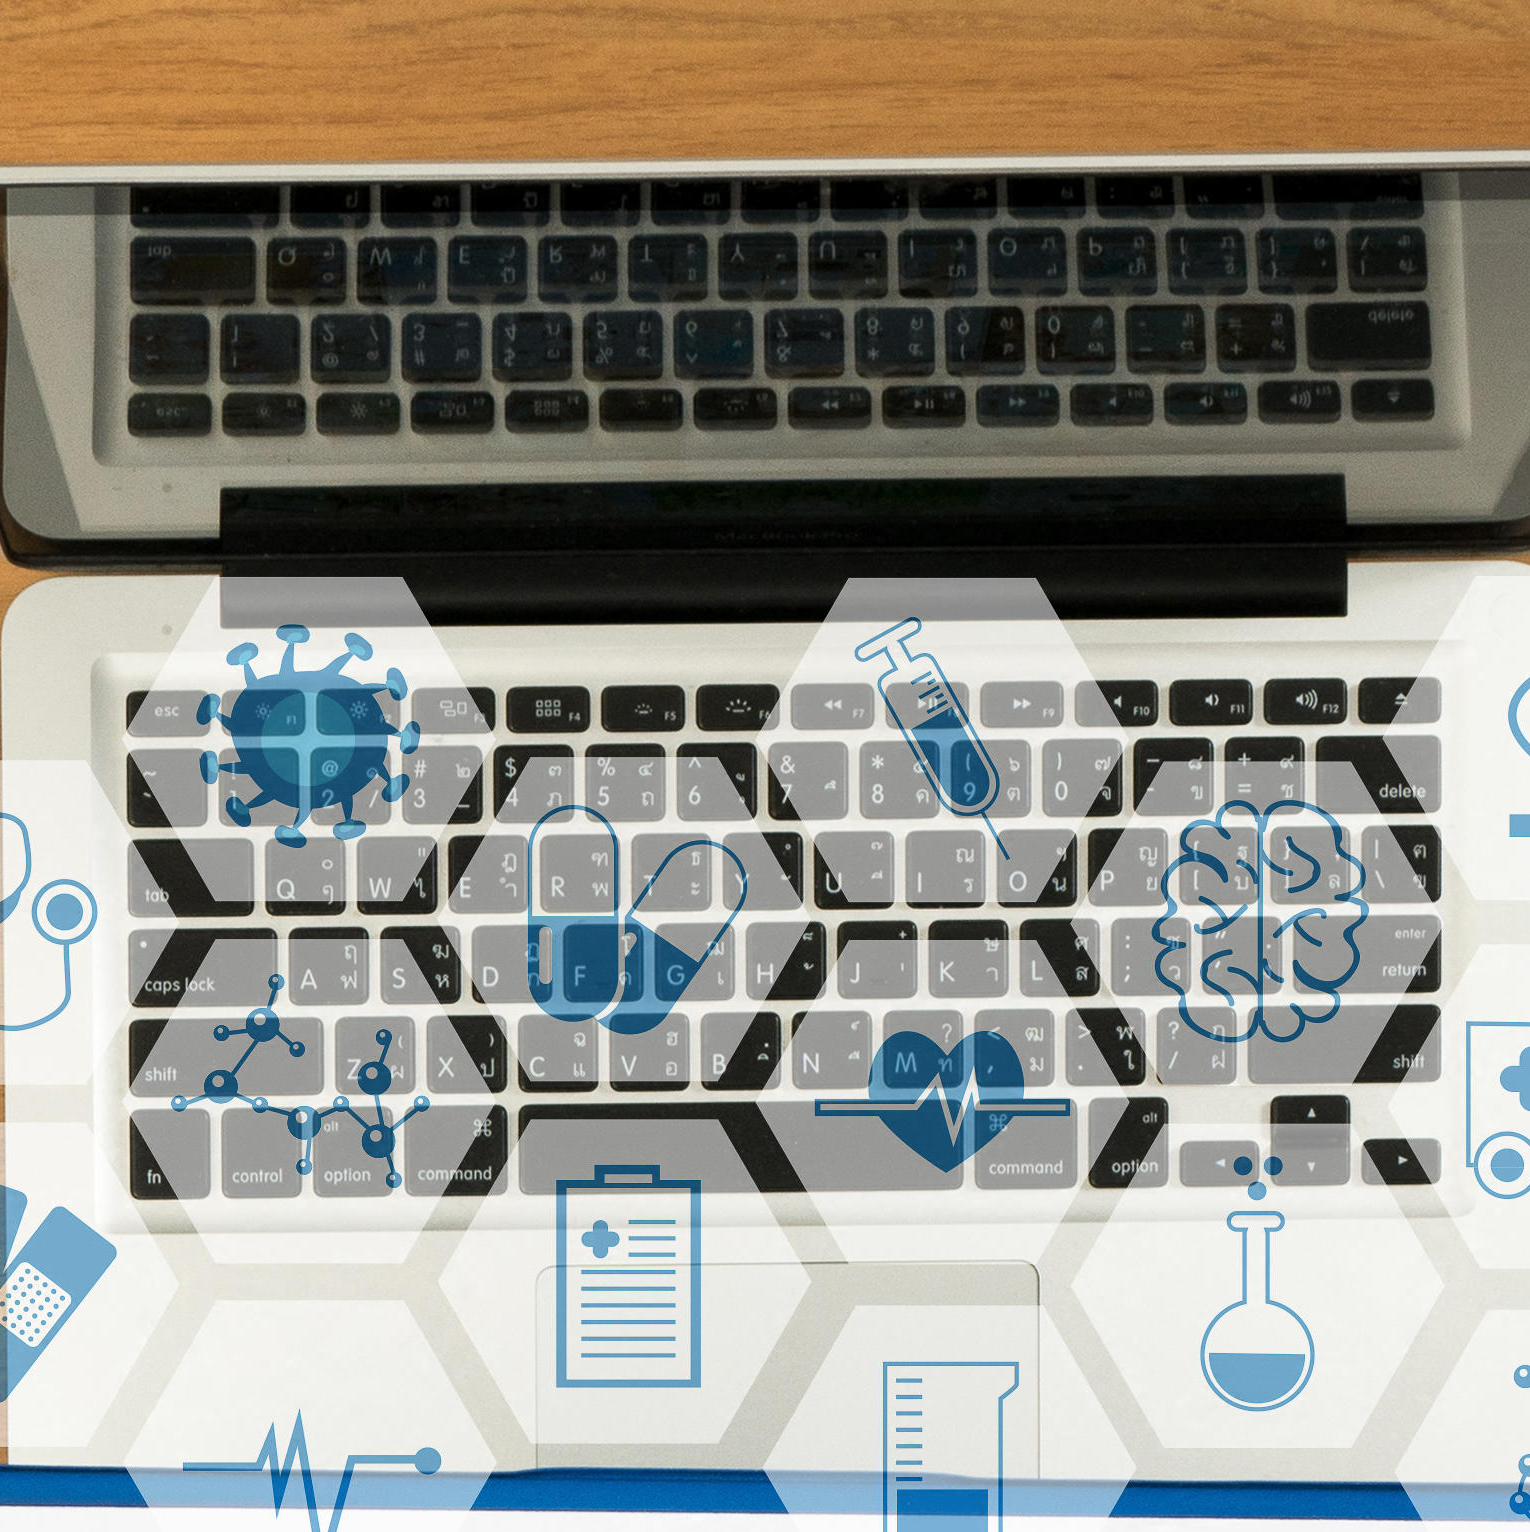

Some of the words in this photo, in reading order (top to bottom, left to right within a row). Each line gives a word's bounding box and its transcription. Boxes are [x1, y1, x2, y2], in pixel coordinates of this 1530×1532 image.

[155, 706, 179, 716] esc
[569, 712, 580, 721] F4
[665, 711, 676, 720] F5
[853, 709, 864, 718] F7
[1043, 708, 1054, 717] F9
[1134, 706, 1150, 715] F10
[1231, 704, 1244, 713] F11
[1323, 704, 1339, 713] F12
[286, 716, 296, 724] F1
[322, 760, 338, 777] @
[414, 760, 426, 778] #
[505, 757, 516, 778] $
[597, 757, 615, 776] %
[780, 755, 795, 774] &
[322, 789, 333, 808] 2
[414, 788, 425, 808] 3
[503, 786, 518, 807] 4
[597, 786, 609, 806] 5
[689, 786, 701, 805] 6
[782, 785, 791, 804] 7
[872, 784, 884, 803] 8
[964, 783, 976, 801] 9
[1379, 784, 1425, 798] delete
[369, 878, 391, 898] W
[460, 877, 471, 897] E
[552, 876, 564, 897] R
[643, 876, 657, 895] T
[735, 874, 749, 894] Y
[826, 873, 841, 893] U
[1101, 869, 1114, 891] P
[146, 888, 169, 904] tab
[277, 879, 295, 901] Q
[1395, 928, 1426, 939] enter
[301, 969, 317, 989] A
[393, 968, 405, 989] S
[483, 966, 499, 987] D
[575, 966, 586, 986] F
[667, 965, 685, 985] G
[757, 963, 773, 984] H
[850, 963, 859, 983] J
[940, 961, 954, 982] K
[1032, 960, 1043, 980] L
[1383, 964, 1426, 976] return
[145, 981, 180, 994] caps
[185, 977, 214, 992] lock
[347, 1059, 362, 1079] Z
[438, 1057, 454, 1077] X
[528, 1056, 545, 1077] C
[621, 1056, 637, 1076] V
[713, 1054, 726, 1074] B
[803, 1053, 819, 1073] N
[895, 1052, 917, 1072] M
[1393, 1054, 1423, 1068] shift
[145, 1067, 176, 1081] shift
[324, 1121, 338, 1132] alt
[1143, 1112, 1157, 1123] alt
[148, 1170, 161, 1183] fn
[232, 1168, 282, 1183] control
[324, 1168, 370, 1184] option
[418, 1167, 491, 1180] command
[989, 1160, 1063, 1174] command
[1112, 1159, 1157, 1176] option
